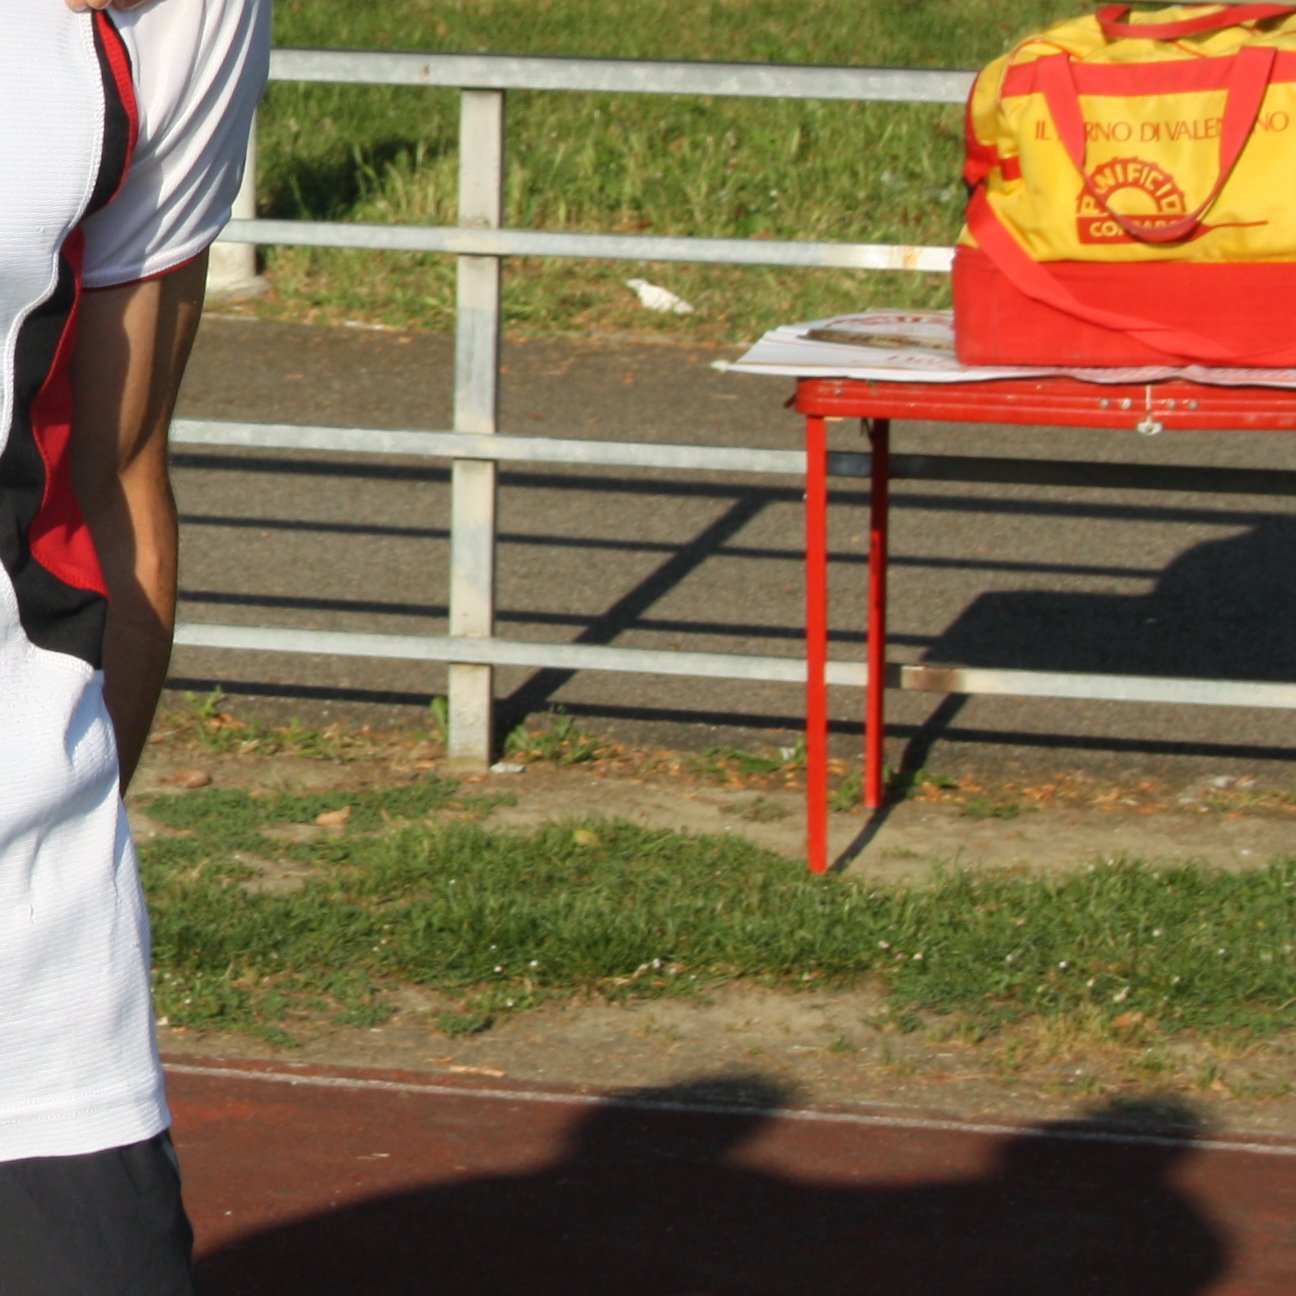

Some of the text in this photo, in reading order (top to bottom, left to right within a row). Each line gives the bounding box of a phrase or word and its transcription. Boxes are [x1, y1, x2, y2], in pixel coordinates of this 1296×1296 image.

[1035, 119, 1052, 141] IL
[1139, 121, 1160, 143] DI
[1165, 110, 1290, 142] VALENO
[1080, 162, 1182, 215] PNIFICIO
